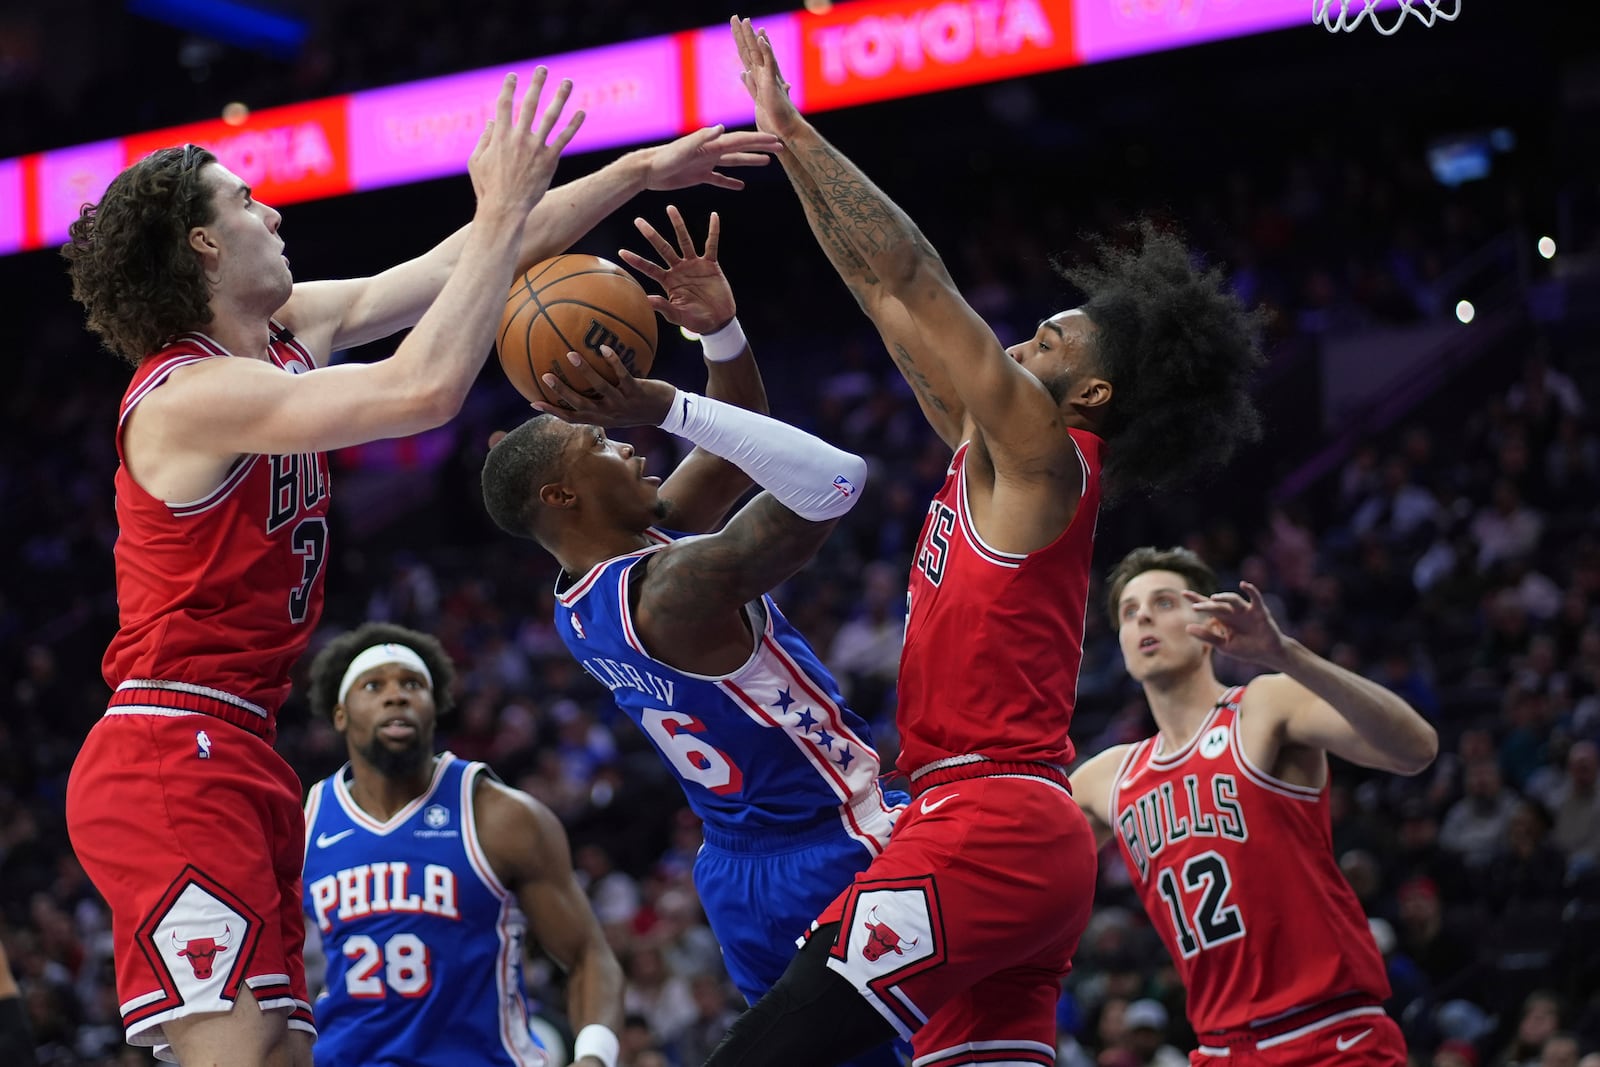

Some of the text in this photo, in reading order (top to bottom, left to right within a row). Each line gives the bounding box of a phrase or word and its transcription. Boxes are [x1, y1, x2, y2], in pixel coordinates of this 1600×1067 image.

[812, 0, 1054, 85] TOYOTA
[288, 516, 328, 624] 3
[641, 707, 743, 796] 6
[1118, 773, 1249, 884] BULLS
[310, 861, 462, 934] PHILA
[1156, 849, 1246, 960] 12
[342, 933, 432, 998] 28
